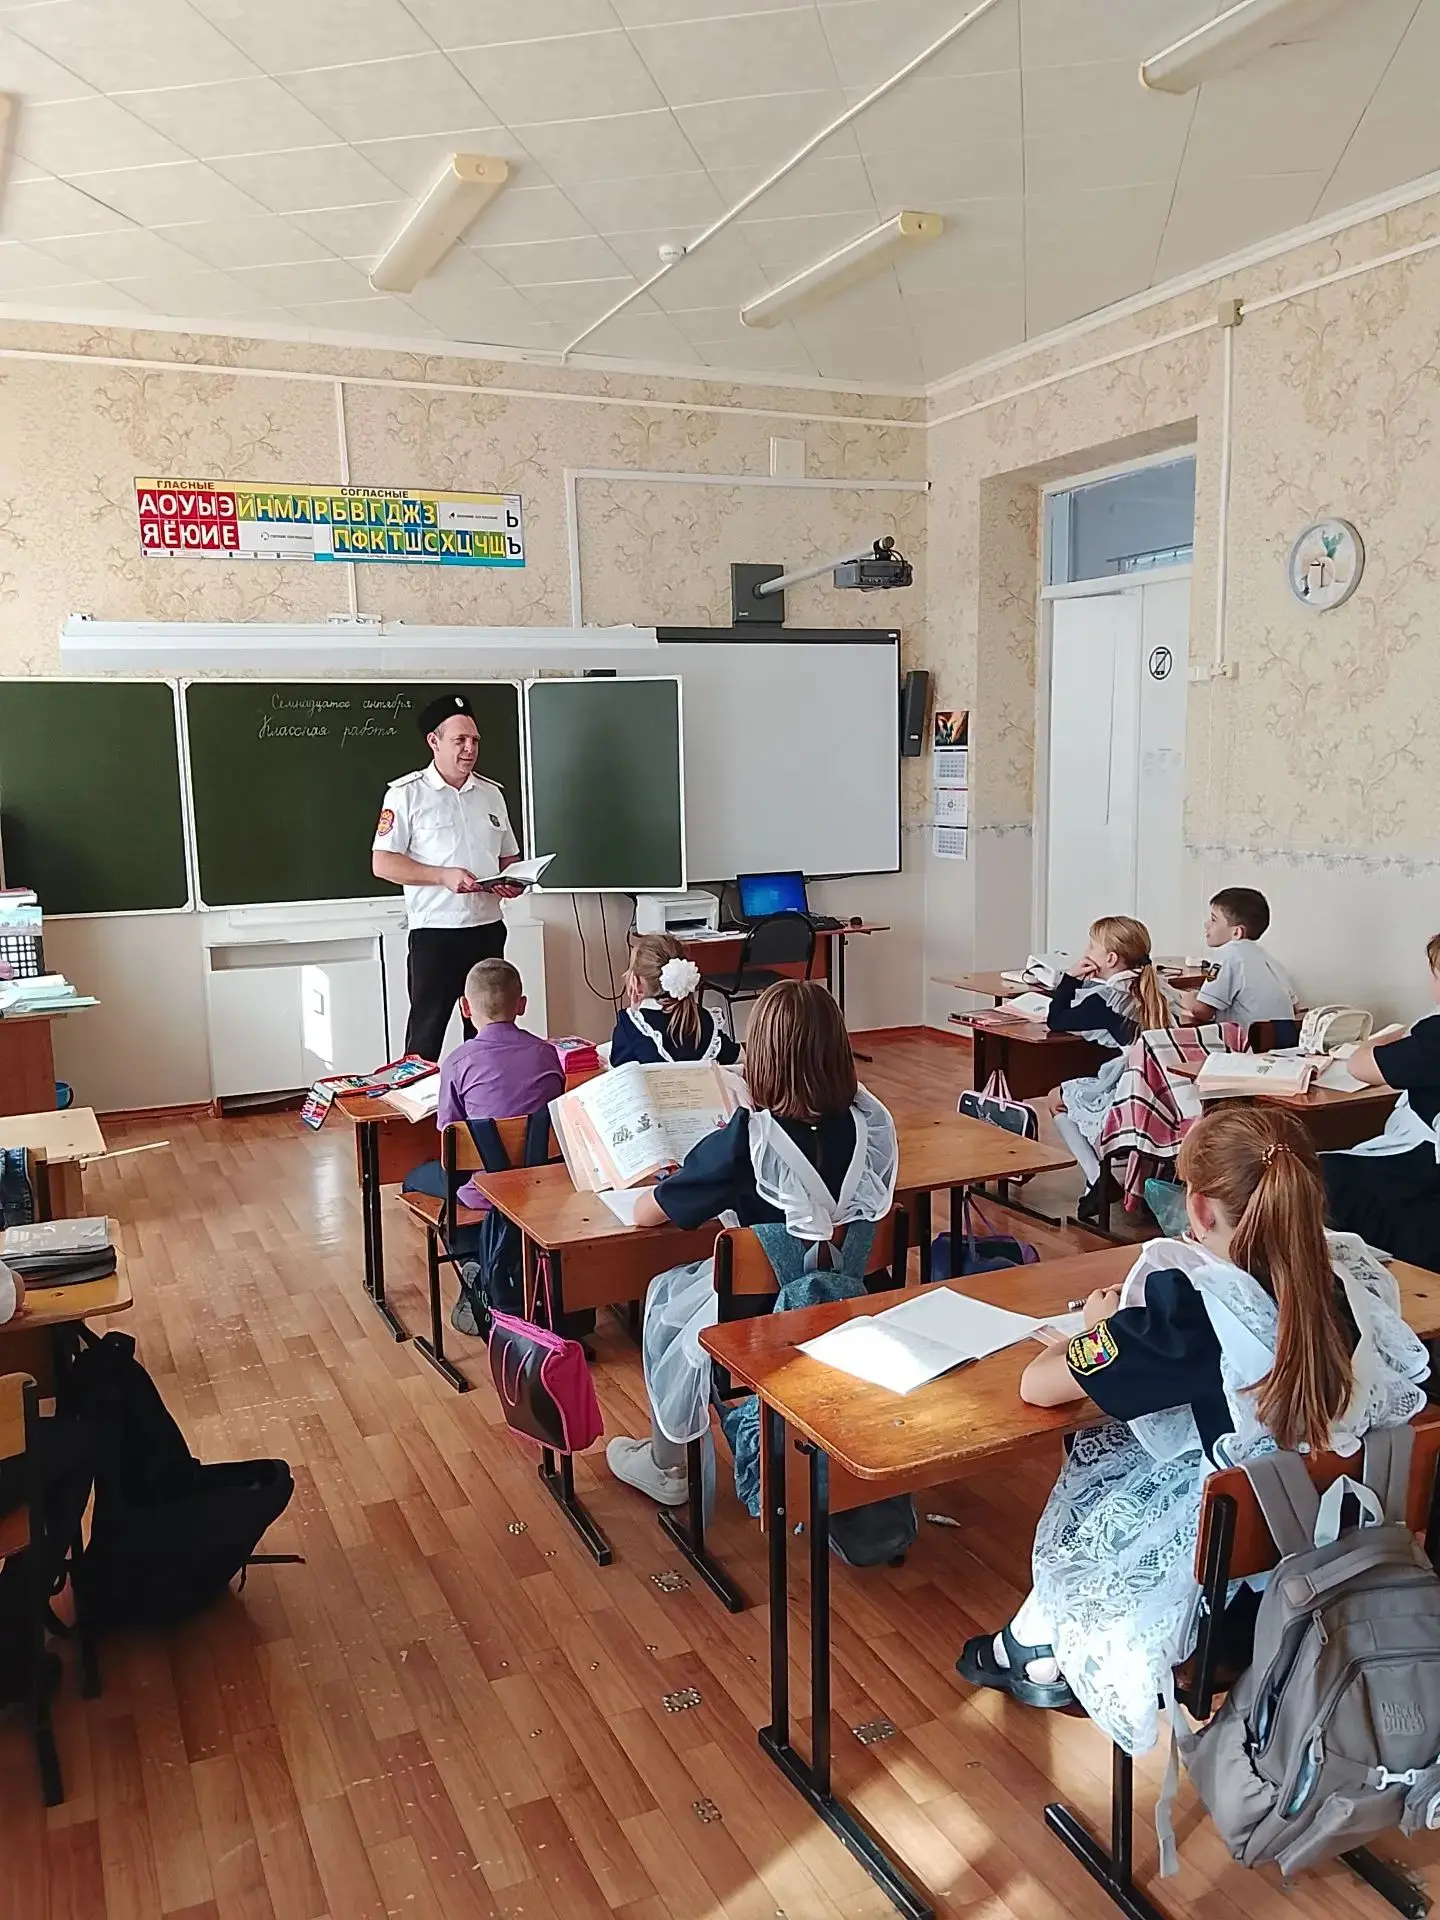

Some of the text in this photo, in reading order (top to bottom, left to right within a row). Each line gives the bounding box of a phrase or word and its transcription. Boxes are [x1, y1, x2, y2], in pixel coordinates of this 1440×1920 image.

[156, 480, 215, 490] ГЛАСНЫЕ
[340, 488, 409, 499] СОГЛАСНЫЕ
[271, 692, 351, 719] Семнадцатое
[258, 714, 398, 749] Классная работа
